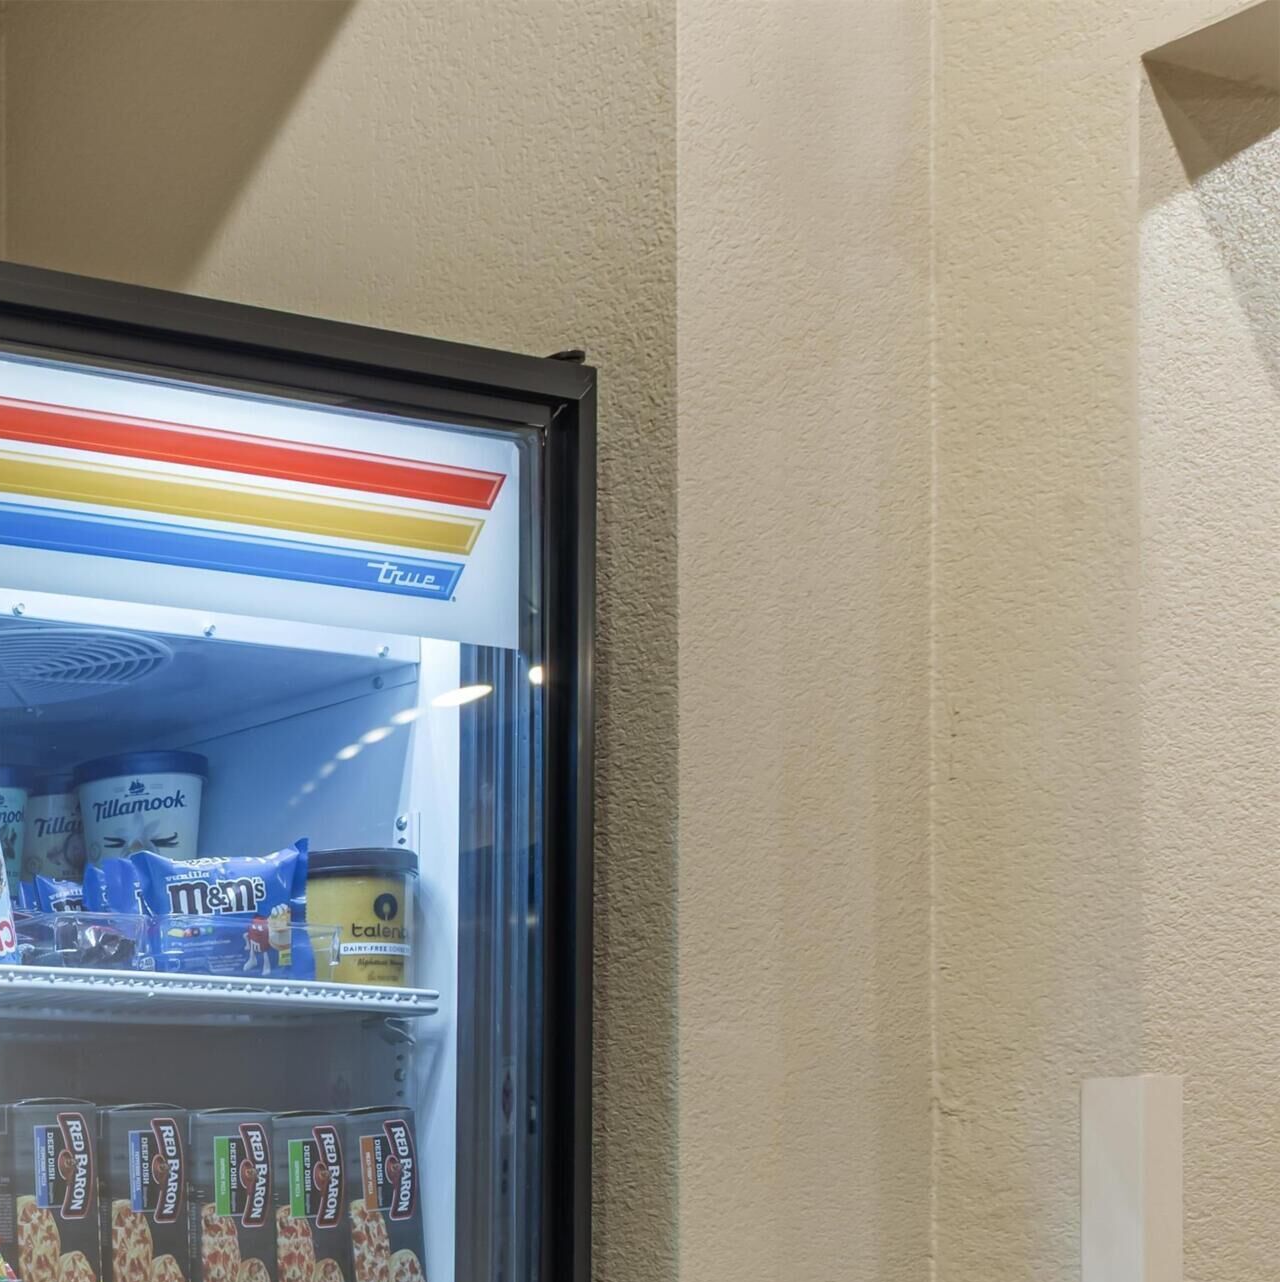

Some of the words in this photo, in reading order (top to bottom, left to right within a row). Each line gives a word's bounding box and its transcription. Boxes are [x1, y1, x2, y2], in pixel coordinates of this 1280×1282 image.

[367, 562, 441, 591] true
[93, 789, 186, 823] Tillamook
[165, 870, 210, 882] vanilla
[46, 1131, 54, 1156] DEEP
[66, 1119, 83, 1151] RED
[159, 1125, 175, 1156] RED
[247, 1130, 264, 1161] RED
[320, 1132, 338, 1164] RED
[374, 1138, 382, 1162] DEEP
[391, 1126, 409, 1157] RED
[48, 1156, 56, 1180] DISH
[229, 1142, 237, 1166] DEEP
[69, 1153, 89, 1211] BARON
[162, 1158, 180, 1215] BARON
[376, 1162, 384, 1185] DISH
[397, 1158, 413, 1213] BARON
[250, 1163, 268, 1219] BARON
[323, 1165, 340, 1221] BARON
